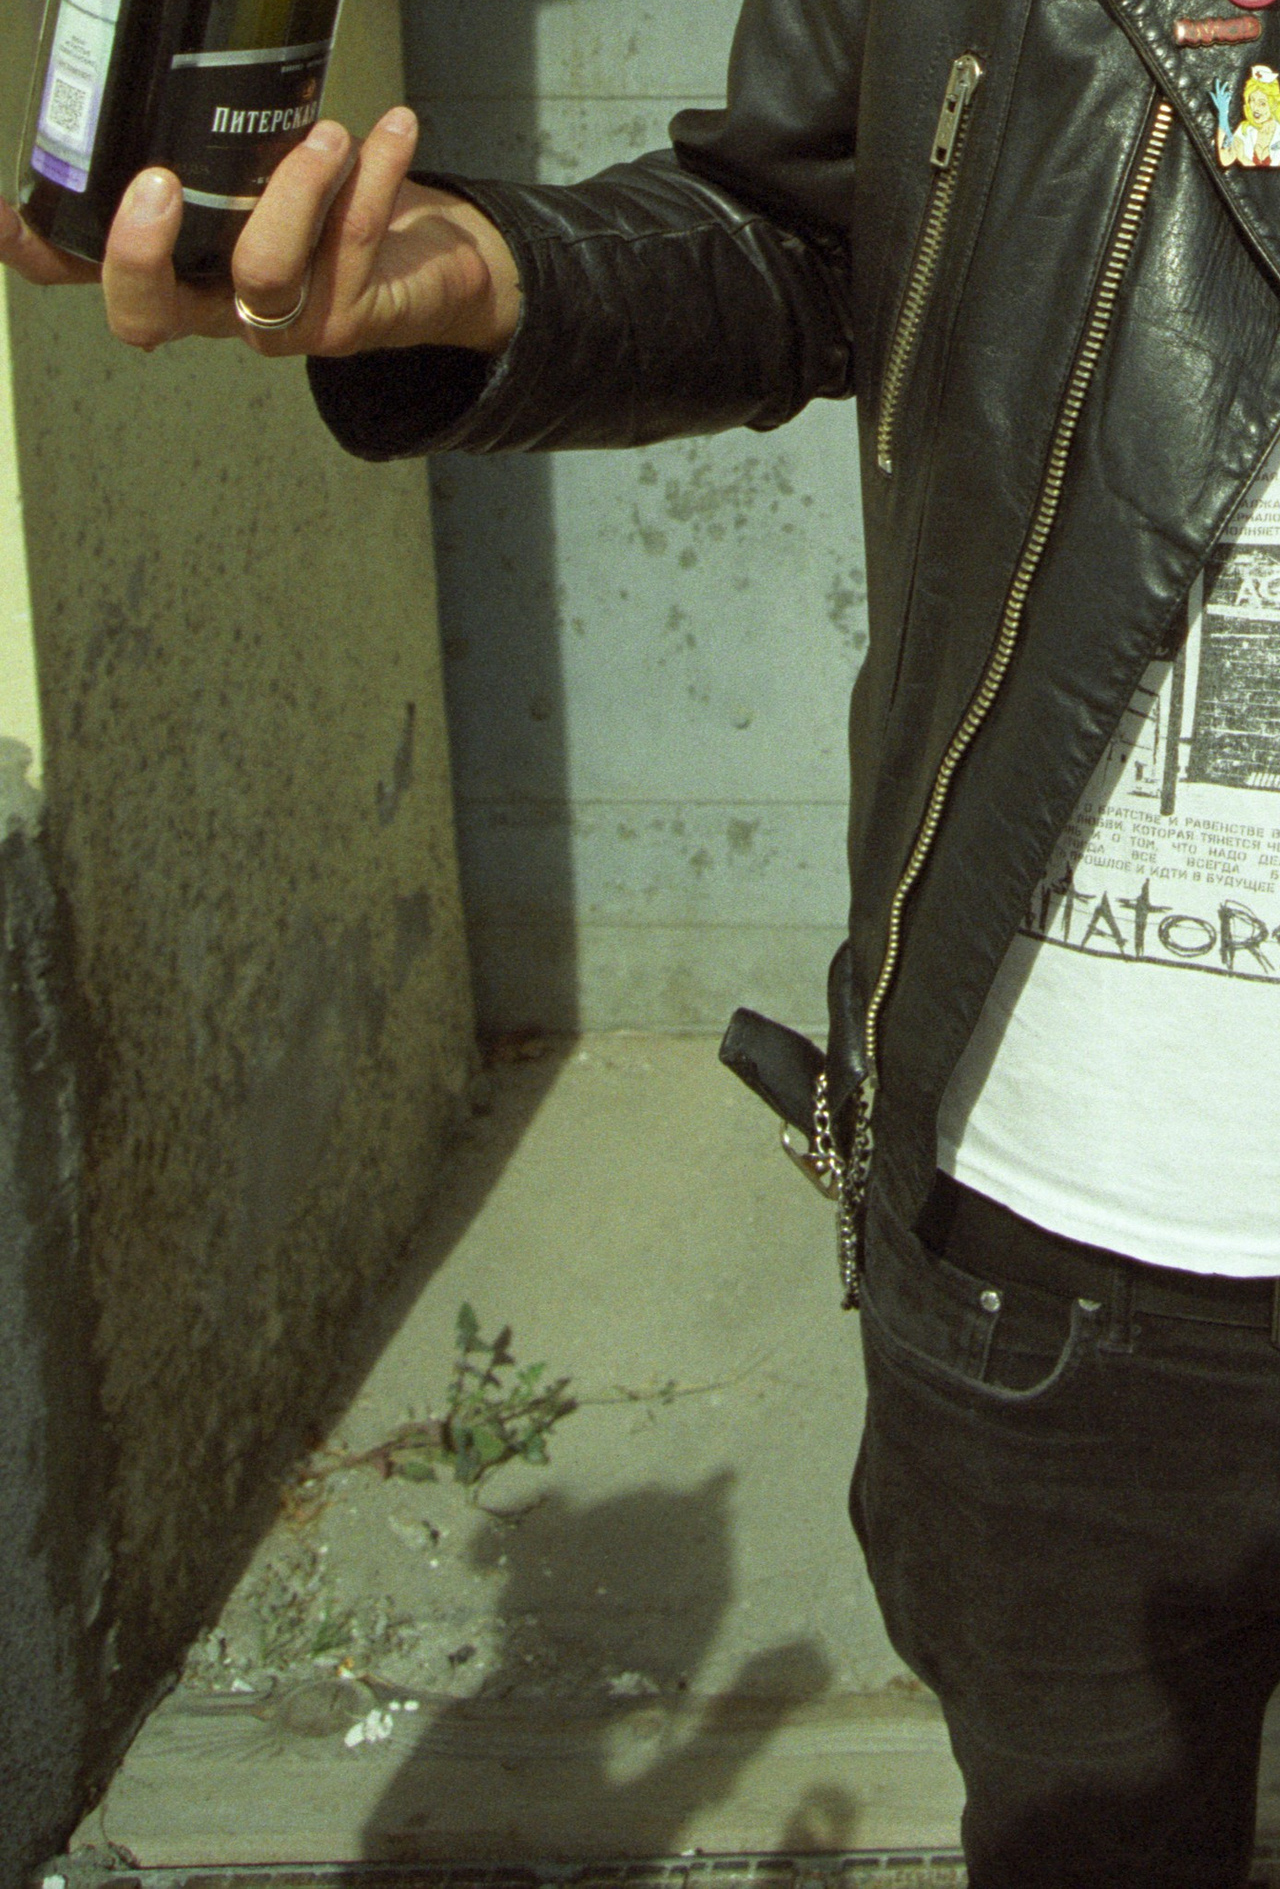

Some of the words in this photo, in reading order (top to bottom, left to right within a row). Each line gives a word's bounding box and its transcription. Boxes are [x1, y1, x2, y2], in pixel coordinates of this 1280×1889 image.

[1098, 805, 1161, 825] БРАТСТВЕ
[1169, 817, 1178, 826] И
[1185, 816, 1265, 838] РАВЕНСТВЕ
[1132, 823, 1194, 841] КОТОРАЯ
[1201, 832, 1261, 850] ТЯНЕТСЯ
[1131, 851, 1157, 864] ВСЕ
[1187, 857, 1240, 874] ВСЕГДА
[1172, 842, 1197, 855] ЧТО
[1209, 847, 1247, 862] НАДО
[1150, 866, 1188, 879] ИДТИ
[1193, 871, 1201, 882] В
[1206, 872, 1275, 893] БУДУЩЕЕ
